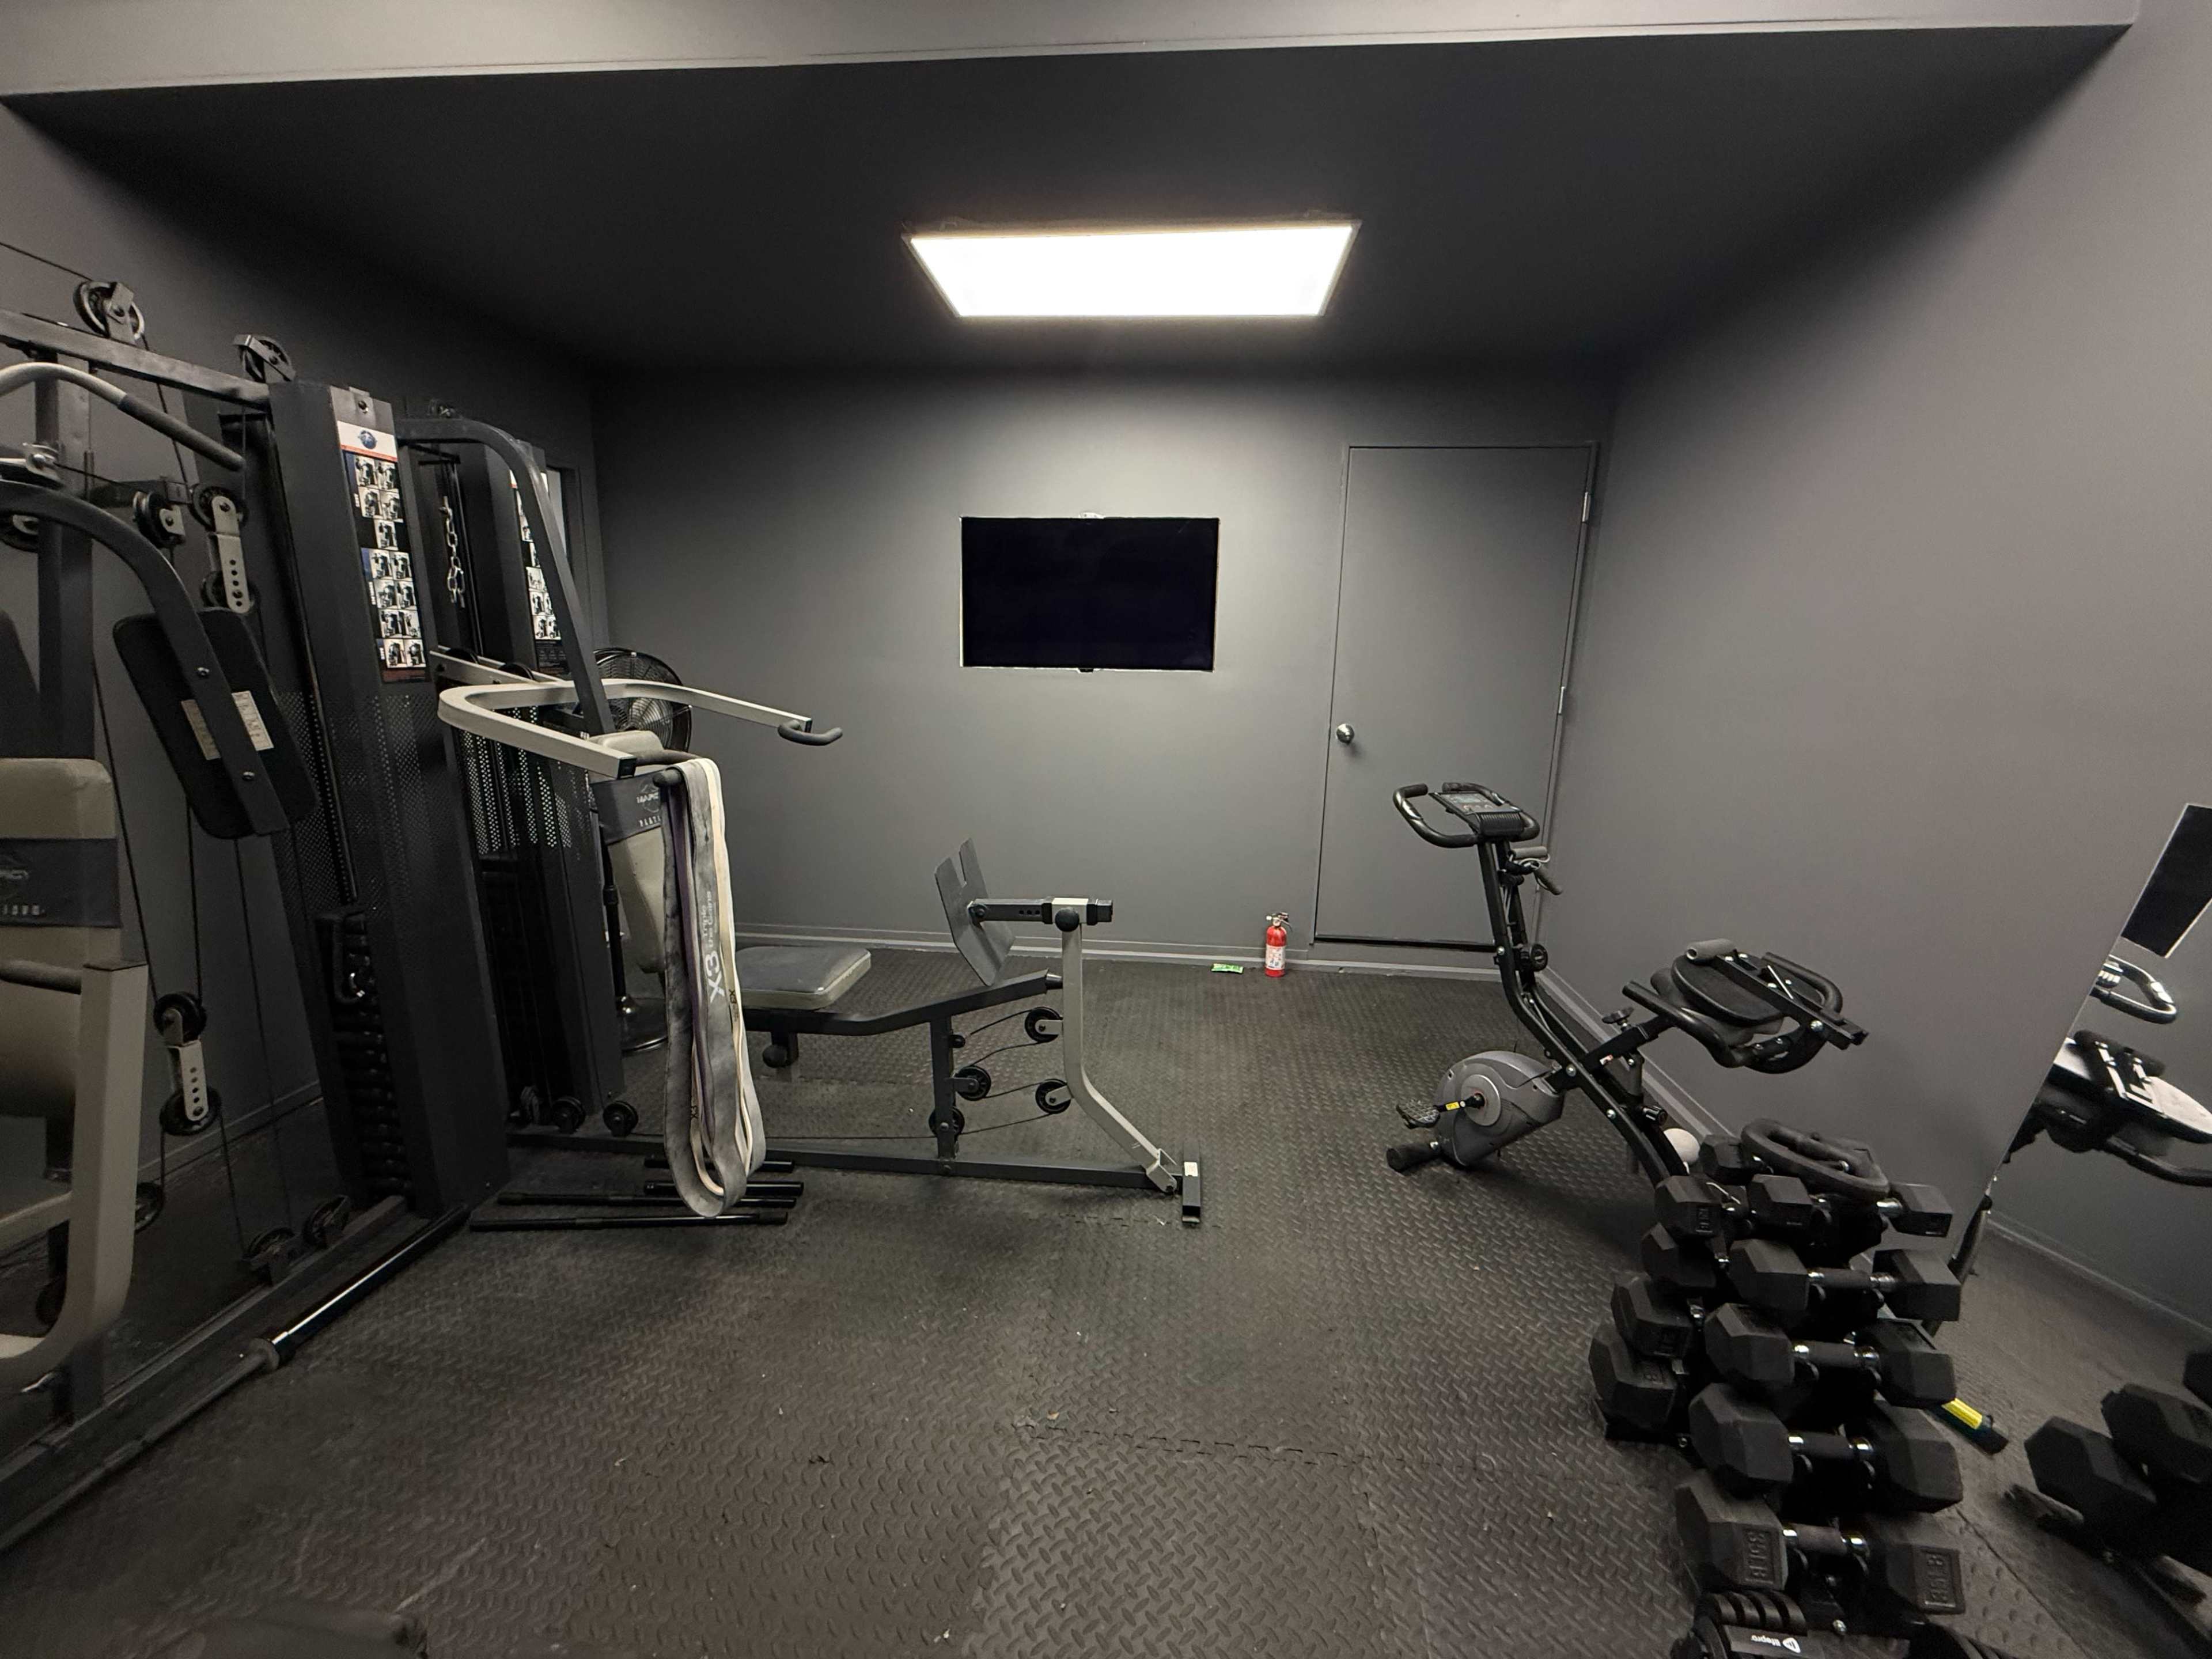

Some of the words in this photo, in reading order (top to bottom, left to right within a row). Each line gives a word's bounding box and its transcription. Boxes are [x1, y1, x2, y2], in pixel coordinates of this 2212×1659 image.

[704, 950, 725, 1003] X3
[729, 988, 737, 1003] X3
[1751, 1634, 1781, 1647] lifepro
